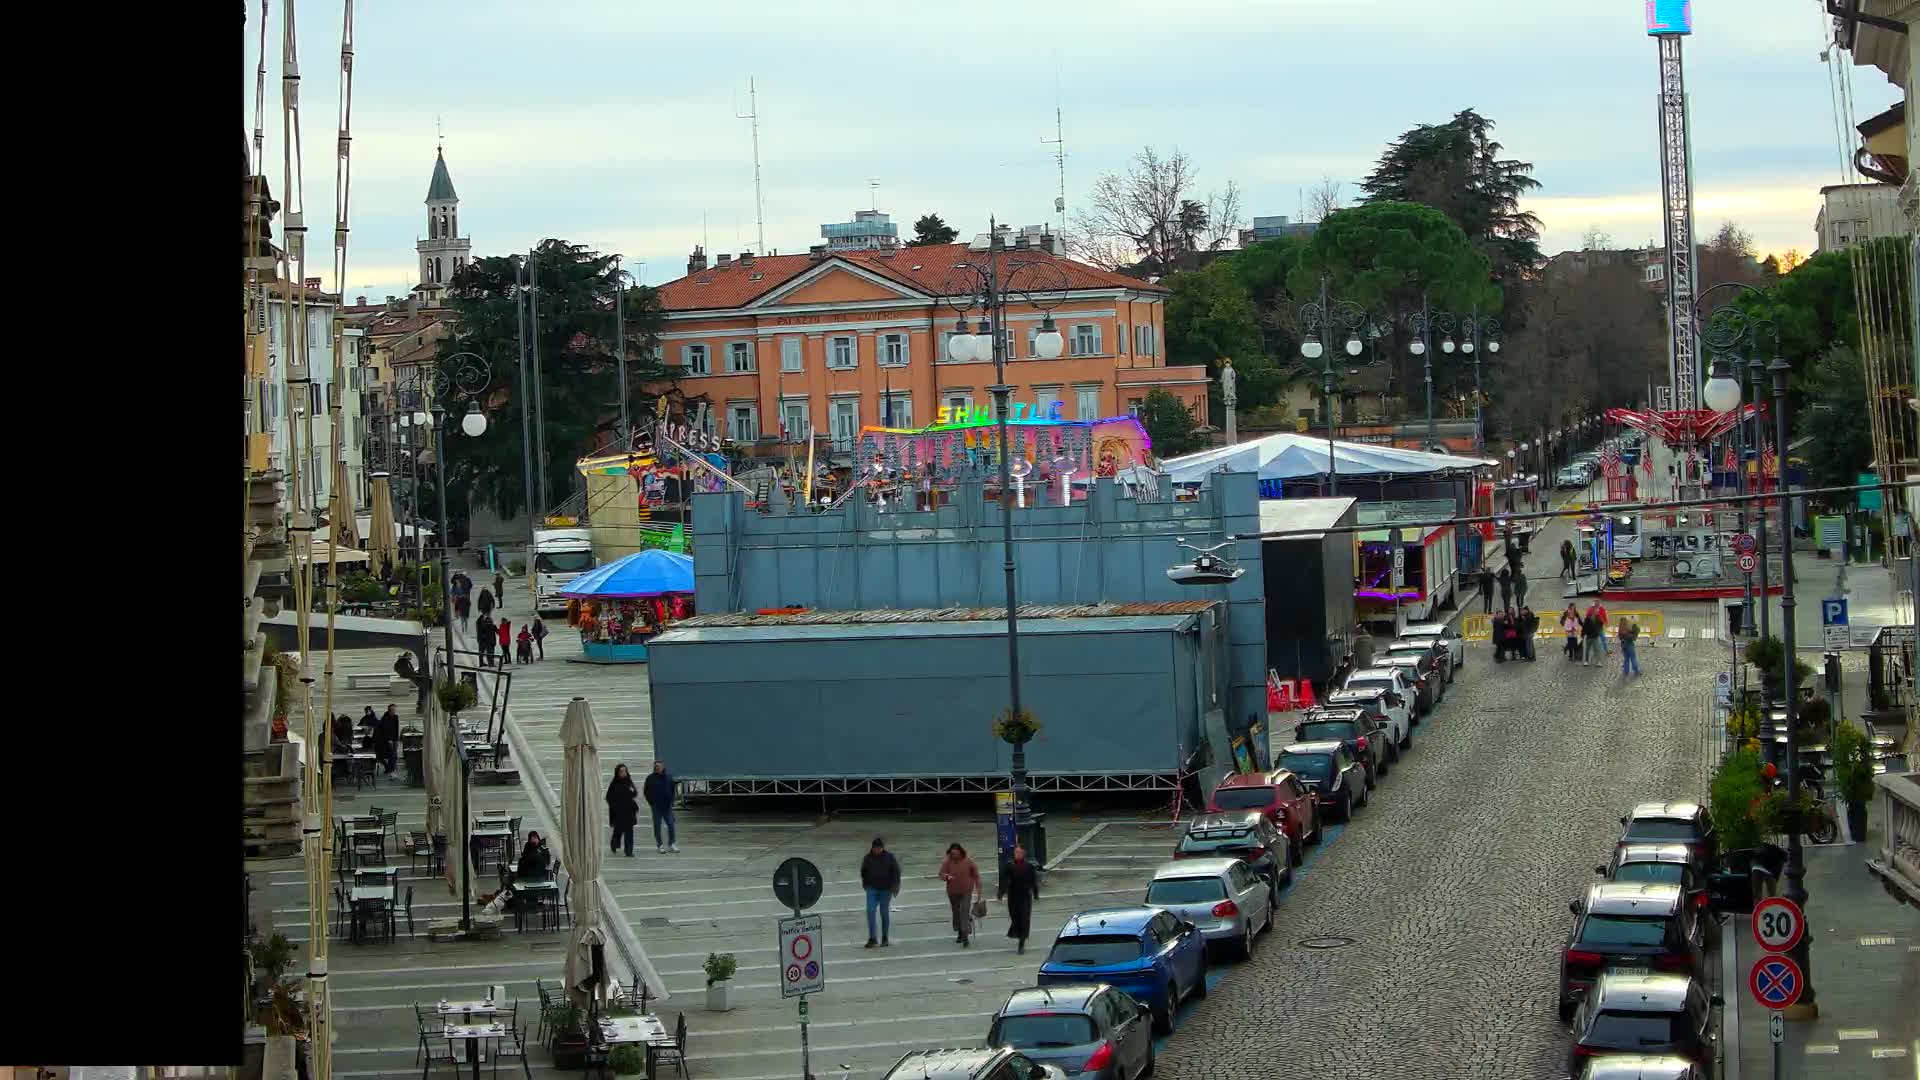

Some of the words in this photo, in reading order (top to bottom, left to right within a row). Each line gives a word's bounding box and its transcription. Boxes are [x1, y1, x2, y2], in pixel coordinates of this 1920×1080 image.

[936, 401, 1065, 424] SHUTLE
[1743, 558, 1753, 568] 20
[1828, 602, 1842, 622] P
[1762, 911, 1792, 938] 30
[789, 969, 799, 979] 20
